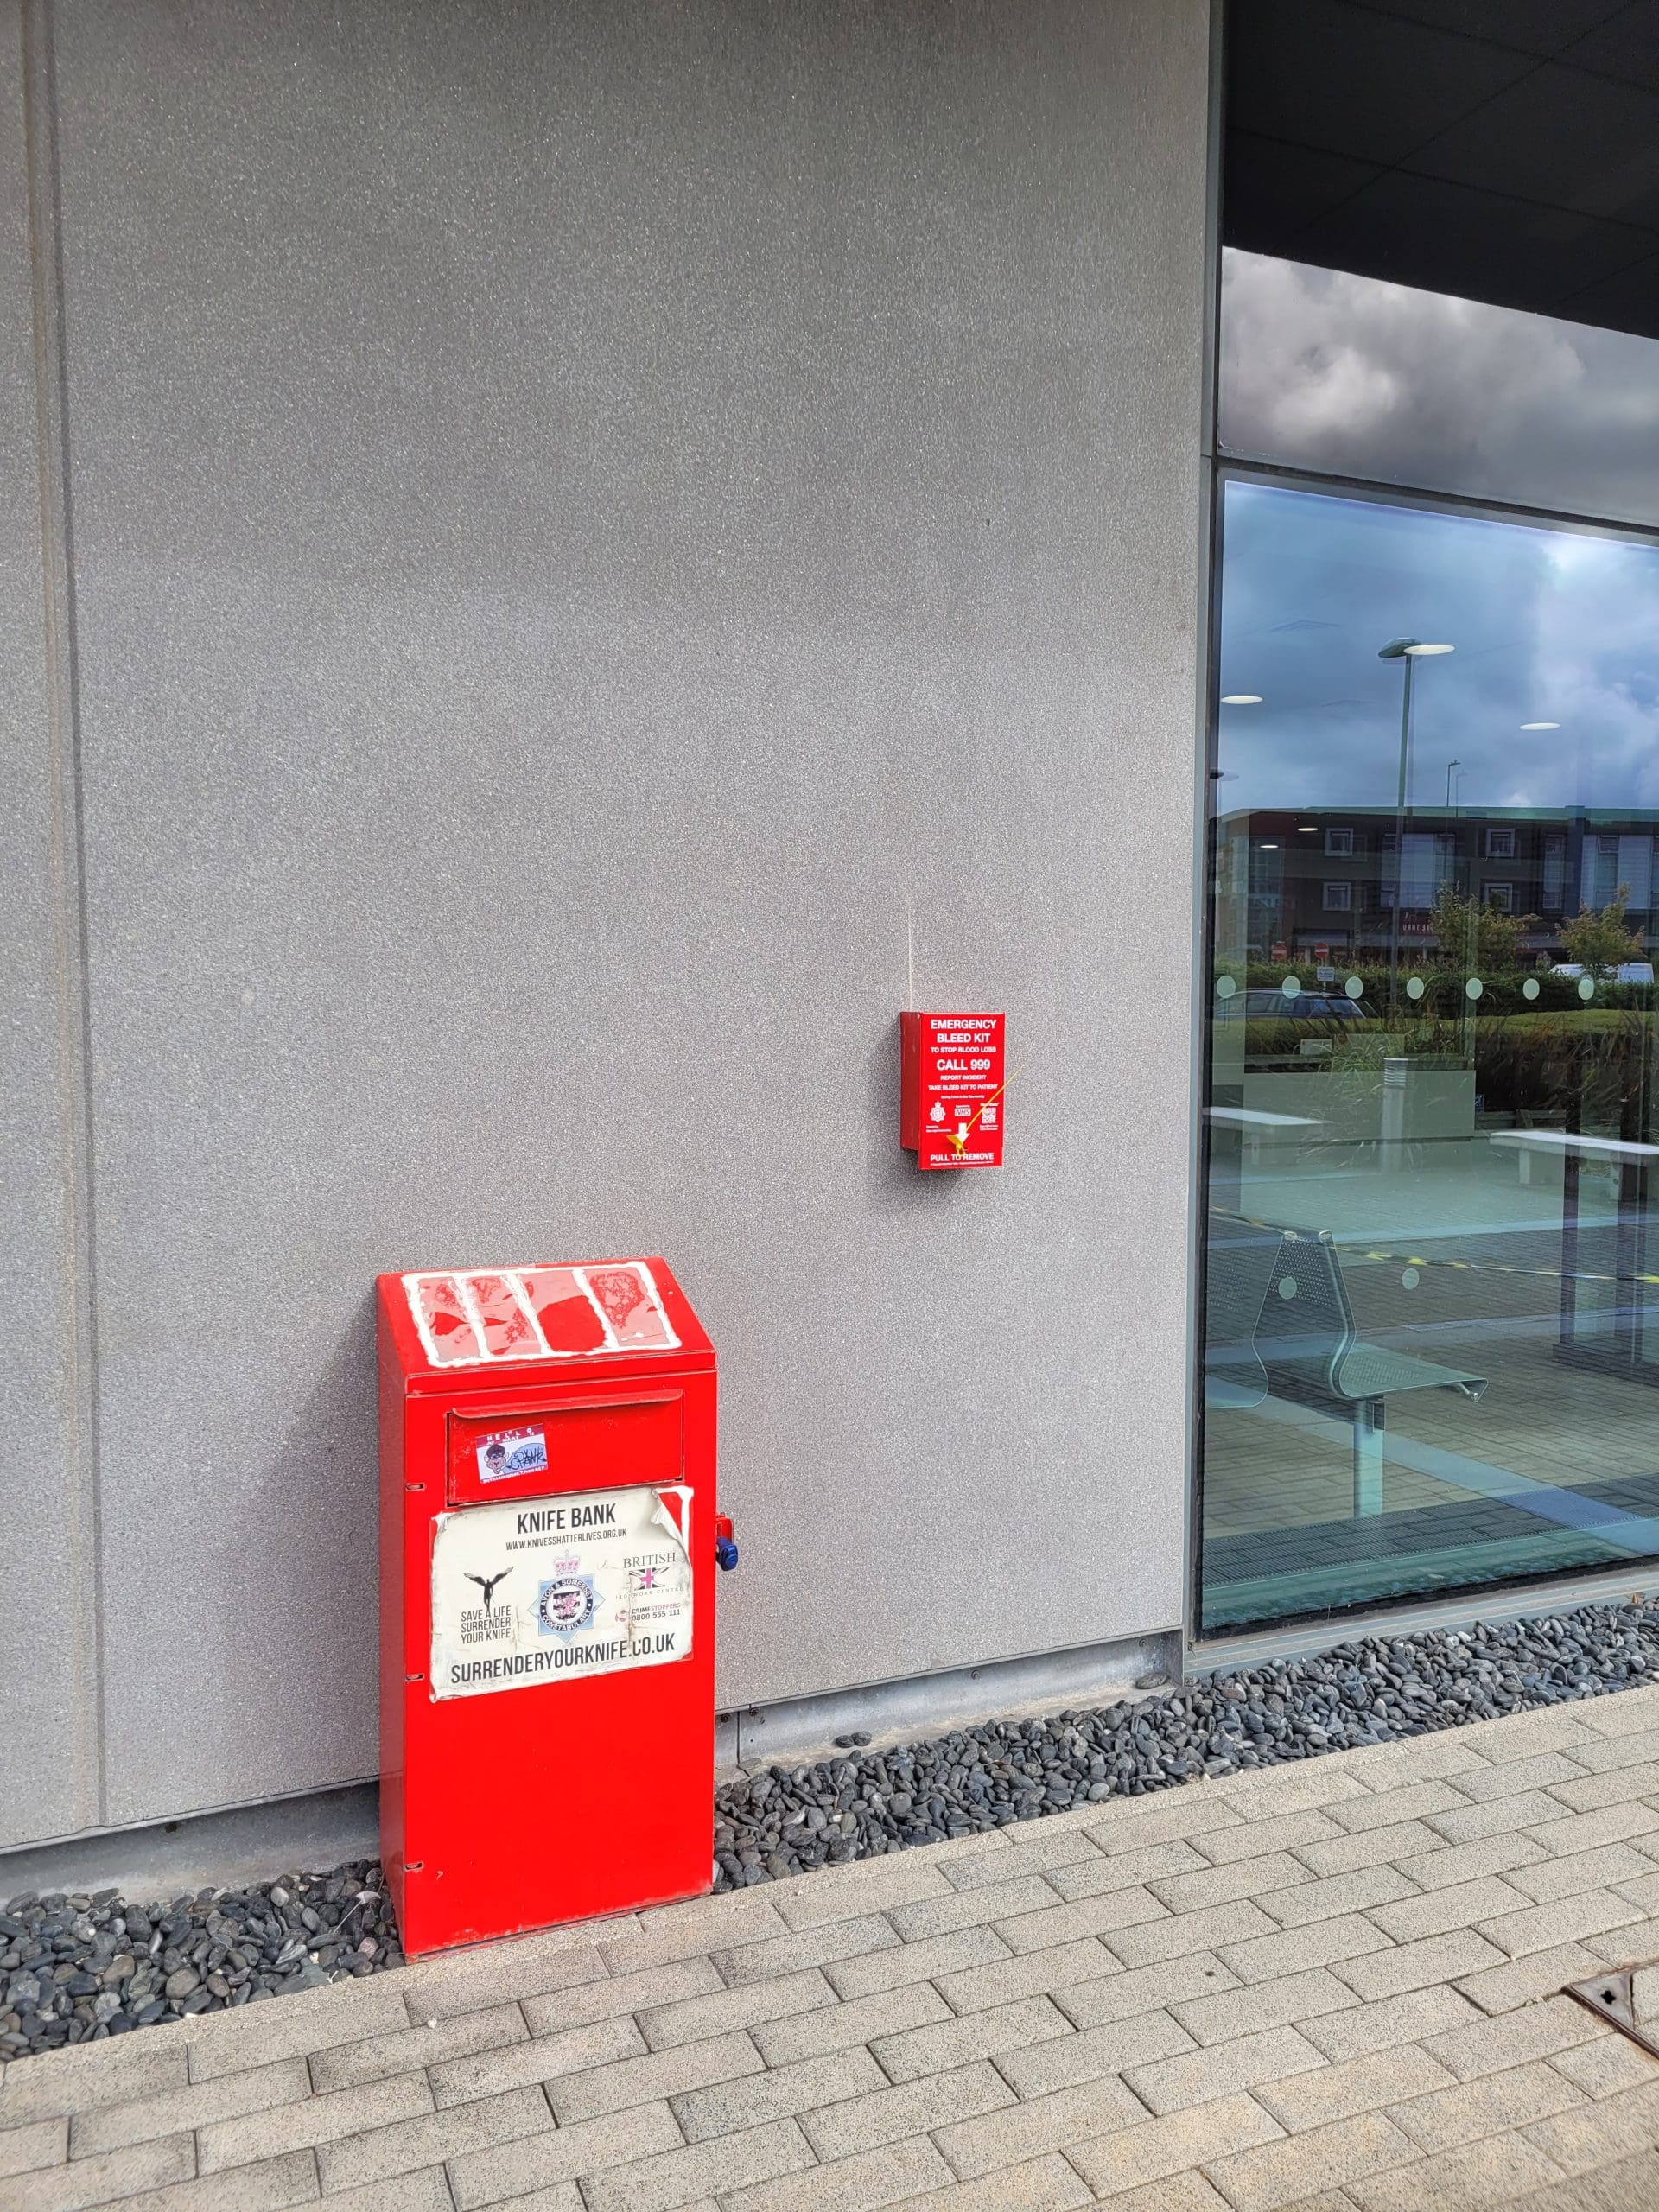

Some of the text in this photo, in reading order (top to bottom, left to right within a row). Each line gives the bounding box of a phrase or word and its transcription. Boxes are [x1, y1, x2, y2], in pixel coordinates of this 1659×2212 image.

[931, 1019, 997, 1029] EMERGENCY
[937, 1033, 991, 1043] BLEED KIT
[936, 1058, 991, 1071] CALL 999
[930, 1154, 950, 1162] PULL
[518, 1503, 616, 1535] KNIFE BANK
[505, 1528, 627, 1551] WWW.KNIVESSHATTERLIVES.ORG.UK
[623, 1552, 676, 1568] BRITISH
[541, 1586, 555, 1606] AVON
[562, 1578, 594, 1599] SOMERSET
[461, 1605, 511, 1622] SAVE A LIFE
[631, 1602, 681, 1615] CRIMESTOPPERS
[632, 1612, 650, 1621] 0800
[461, 1617, 511, 1633] SURRENDER
[542, 1609, 590, 1632] CONSTABULARY
[461, 1628, 511, 1644] YOUR KNIFE
[450, 1633, 675, 1684] SURRENDERYOURKNIFE.CO.UK
